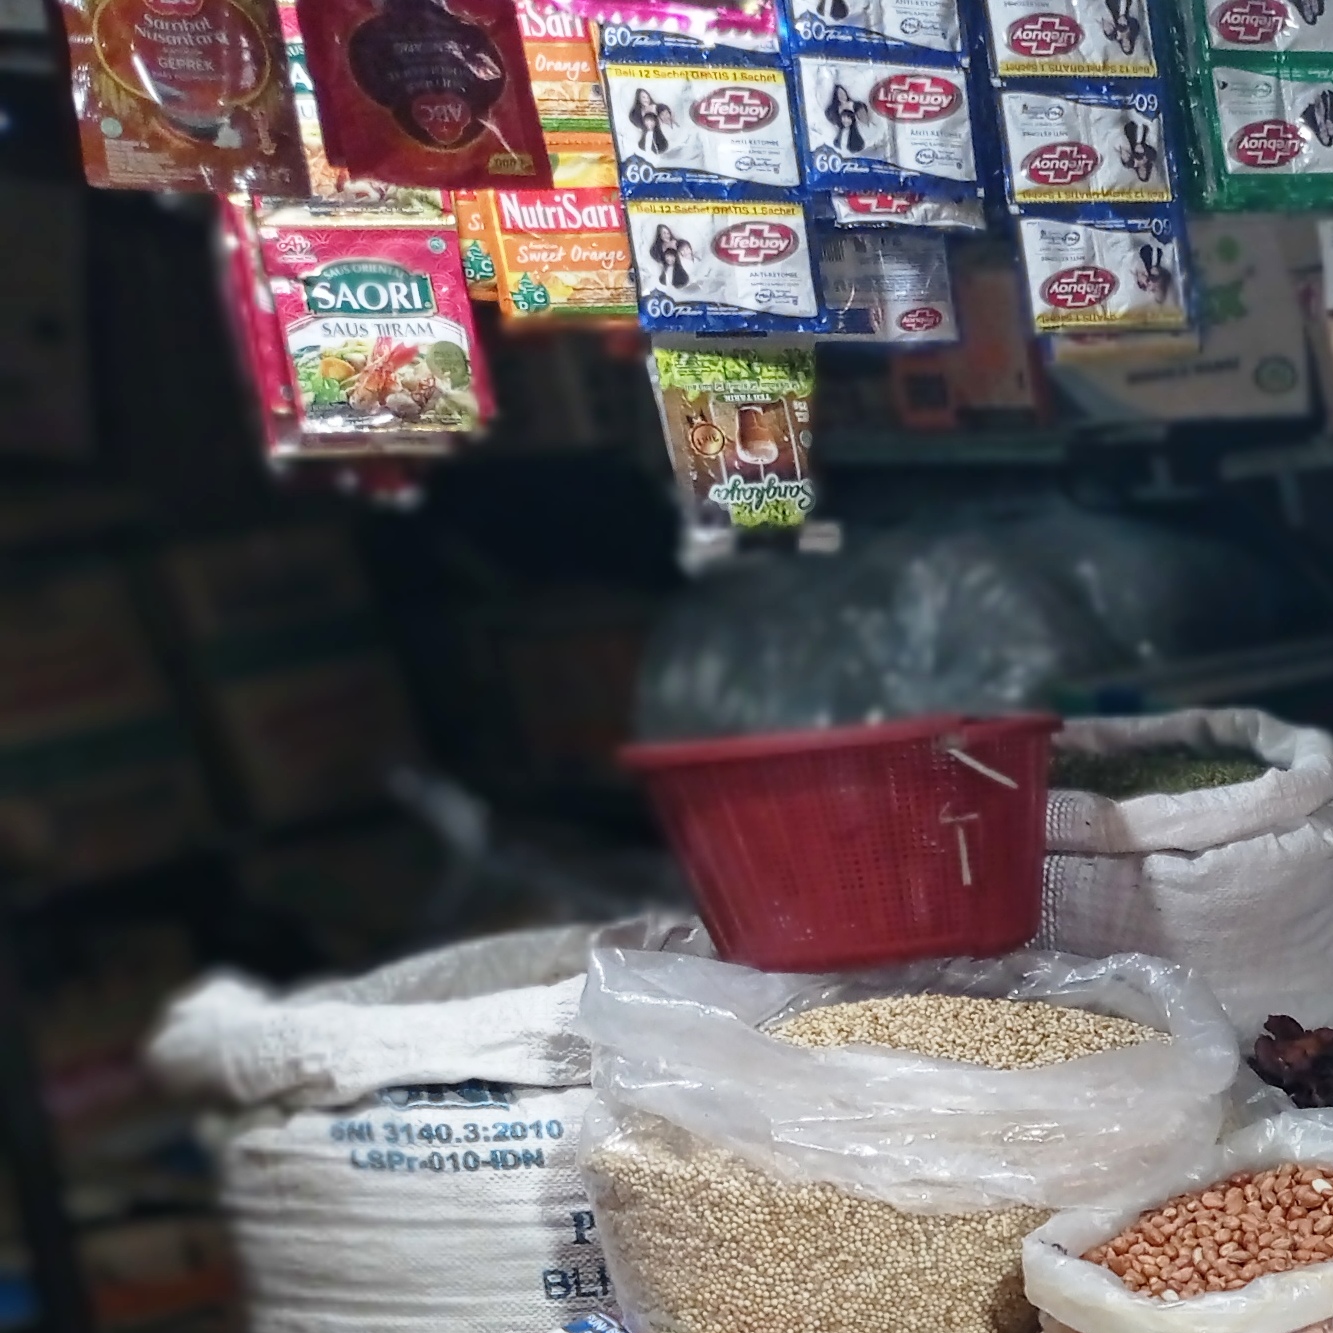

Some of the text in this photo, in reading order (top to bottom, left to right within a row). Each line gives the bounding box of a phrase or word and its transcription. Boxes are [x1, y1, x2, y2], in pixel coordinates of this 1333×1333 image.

[519, 4, 584, 39] iSari
[604, 26, 630, 47] 60
[800, 22, 826, 41] 60
[1012, 29, 1076, 46] Lifebuoy
[534, 53, 592, 81] Orange
[638, 69, 650, 80] 12
[878, 87, 953, 107] Lifebuoy
[1134, 93, 1159, 112] 60
[699, 99, 770, 120] Lifebuoy
[1238, 136, 1303, 153] Lifebuoy
[815, 153, 842, 173] 60
[1030, 157, 1094, 172] Lifebuoy
[626, 162, 654, 184] 60
[500, 192, 622, 229] NutriSari
[659, 205, 672, 216] 12
[1151, 218, 1173, 236] 60
[720, 235, 790, 252] Lifebuoy
[516, 244, 626, 269] Sweet Orange
[311, 282, 424, 311] SAORI
[1049, 282, 1110, 295] Lifebuoy
[647, 300, 674, 318] 60
[321, 321, 437, 338] SAUS TIRAM
[330, 1119, 564, 1145] SNI 3140.3:2010
